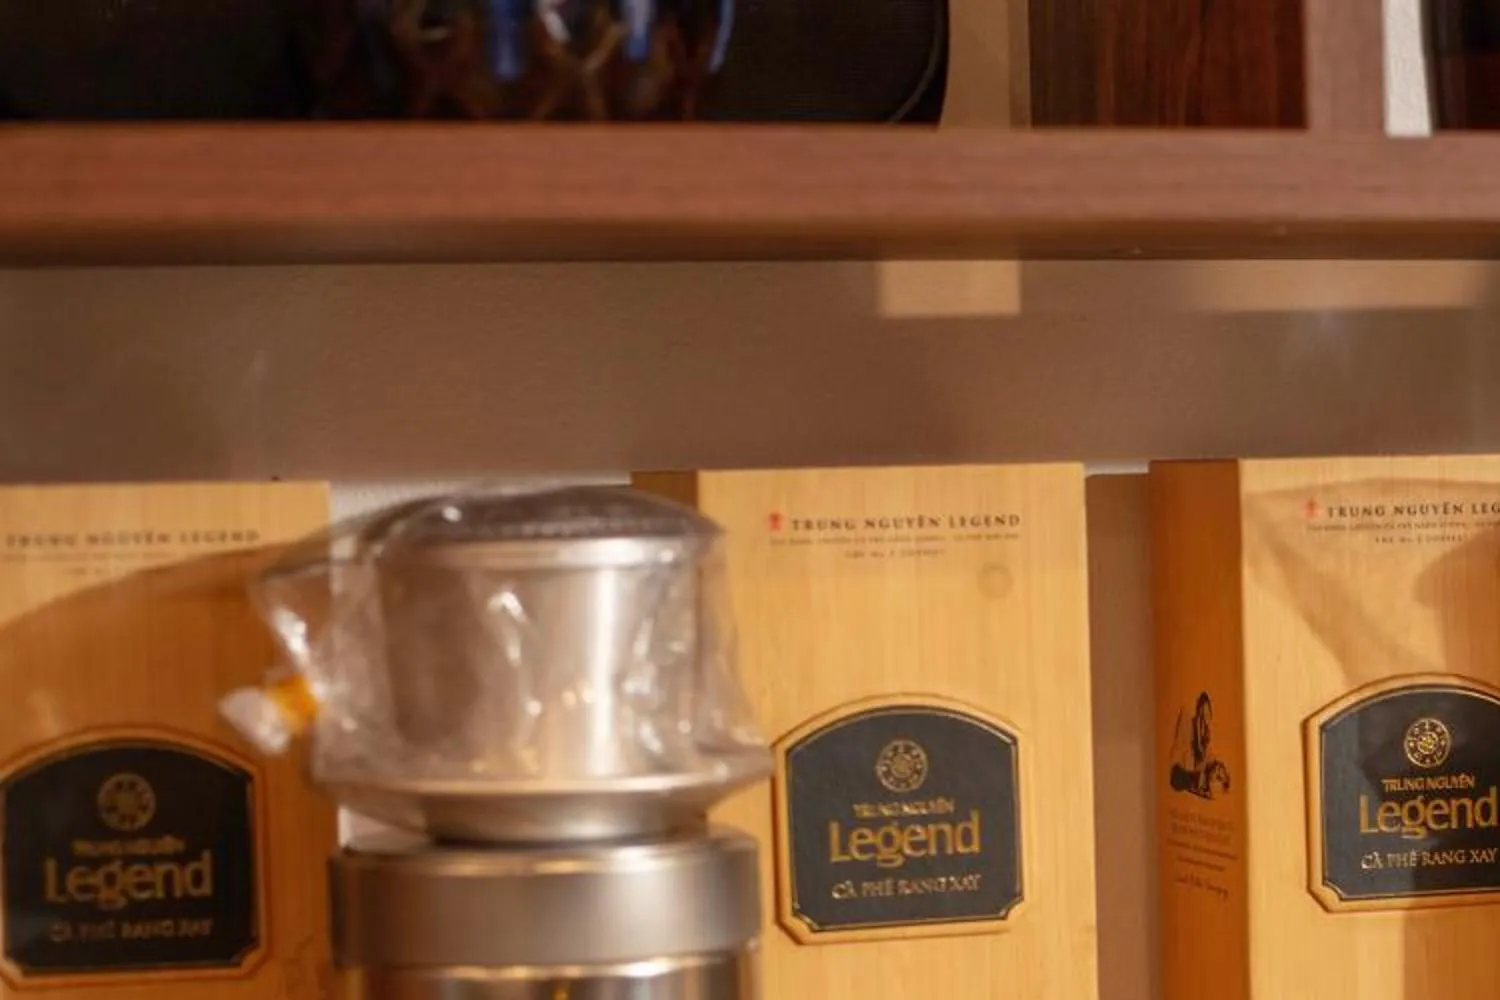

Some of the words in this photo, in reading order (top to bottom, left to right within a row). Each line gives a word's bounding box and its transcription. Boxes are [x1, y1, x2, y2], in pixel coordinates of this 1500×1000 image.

[1327, 504, 1387, 519] TRUNG
[791, 518, 857, 532] TRUNG
[948, 513, 1021, 529] LEGEND
[1358, 785, 1499, 840] Legend
[828, 808, 982, 868] Legend
[1421, 849, 1465, 867] RANG
[1469, 847, 1498, 864] XAY
[43, 849, 213, 911] Legend
[897, 876, 947, 895] RANG
